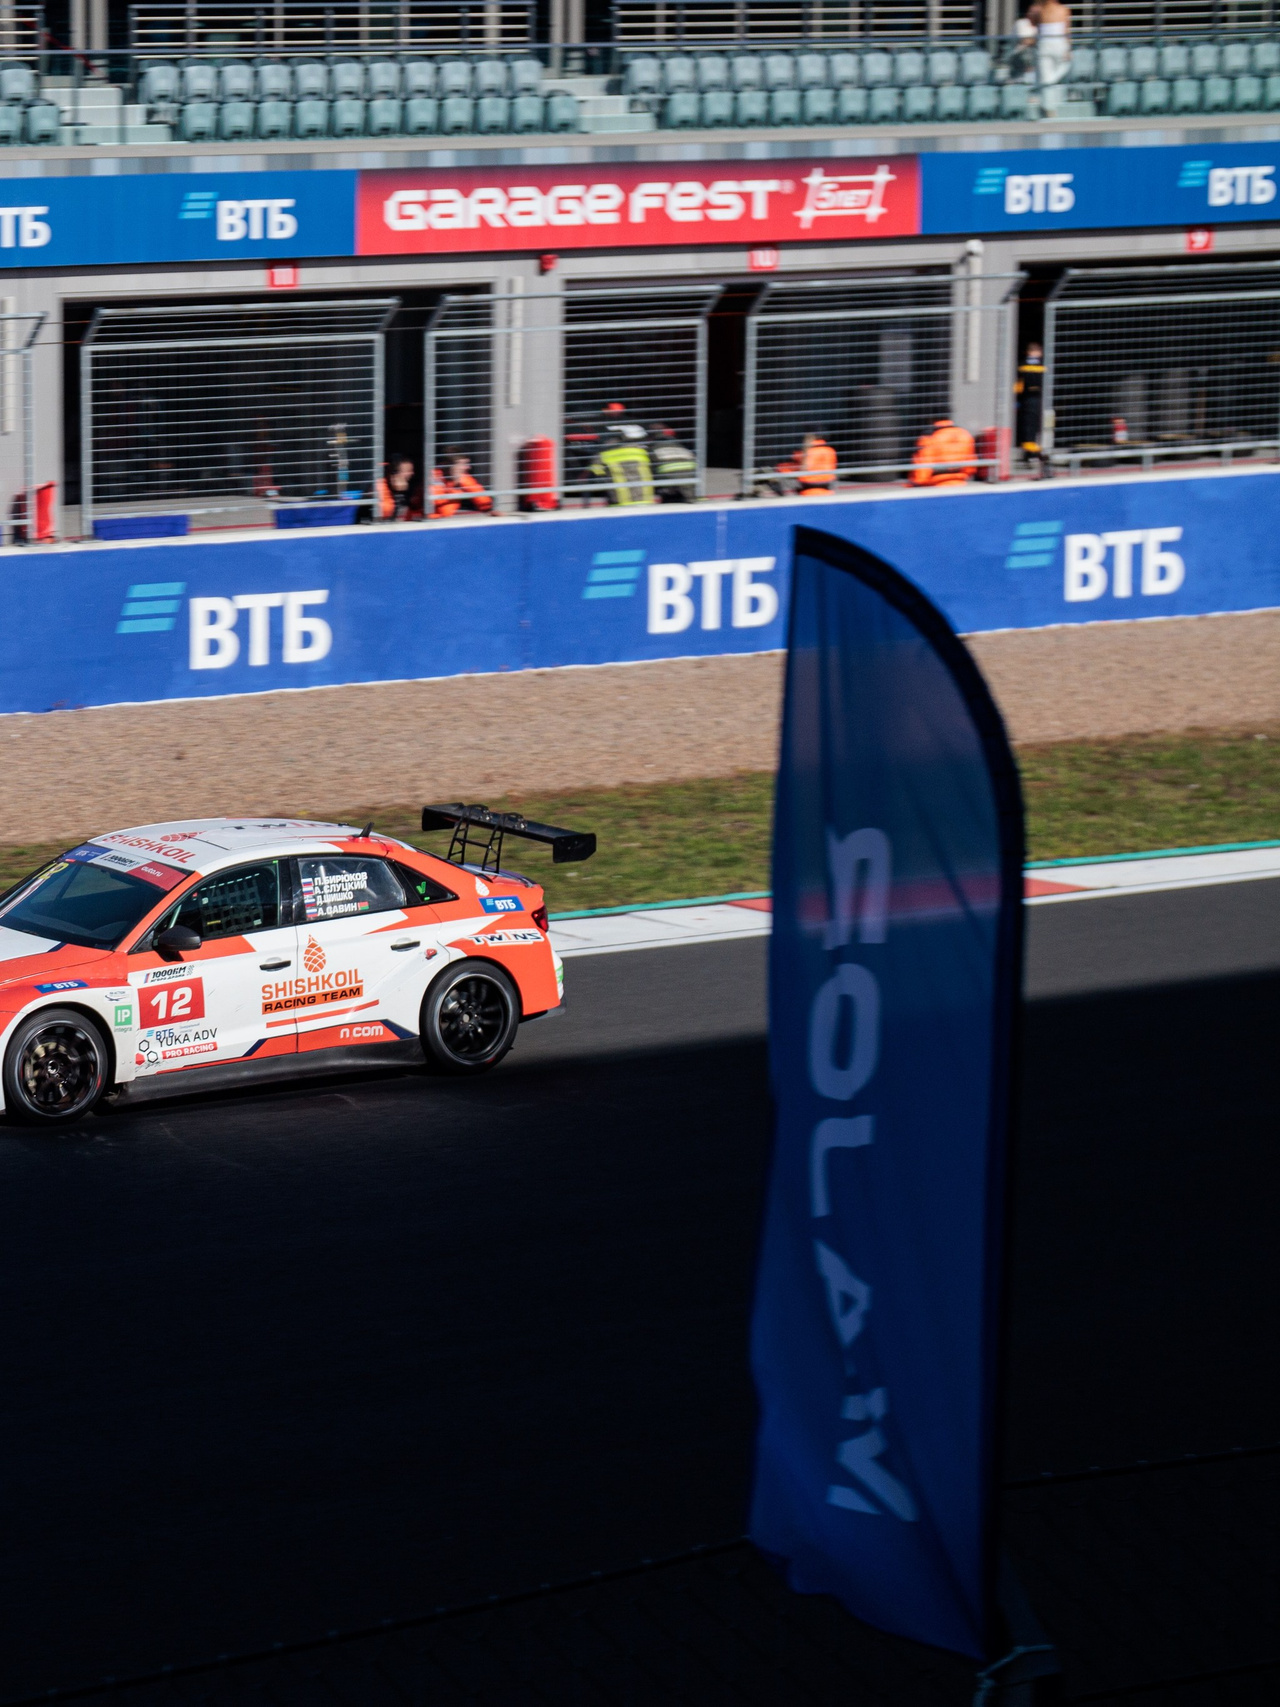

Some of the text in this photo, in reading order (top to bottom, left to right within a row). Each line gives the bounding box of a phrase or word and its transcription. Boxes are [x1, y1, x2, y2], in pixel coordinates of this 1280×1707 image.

[1004, 173, 1076, 215] ВТБ
[1207, 165, 1277, 207] ВТБ
[216, 198, 299, 241] ВТБ
[1063, 526, 1187, 603] ВТБ
[646, 556, 780, 635] ВТБ
[187, 588, 335, 672] ВТБ
[102, 834, 197, 864] SHISHKOIL
[140, 865, 164, 878] auto.ru
[317, 902, 358, 916] А.САВИН
[494, 899, 517, 910] ВТБ
[468, 931, 542, 943] TWINS
[52, 981, 80, 989] ВТБ
[261, 968, 364, 1000] SHISHKOIL
[151, 987, 193, 1020] 12
[264, 987, 361, 1012] RACING TEAM
[117, 1009, 131, 1023] IP
[155, 1028, 175, 1041] ВТБ
[158, 1033, 191, 1048] YUKA
[193, 1028, 218, 1042] ADV
[165, 1043, 215, 1058] PRO RACING
